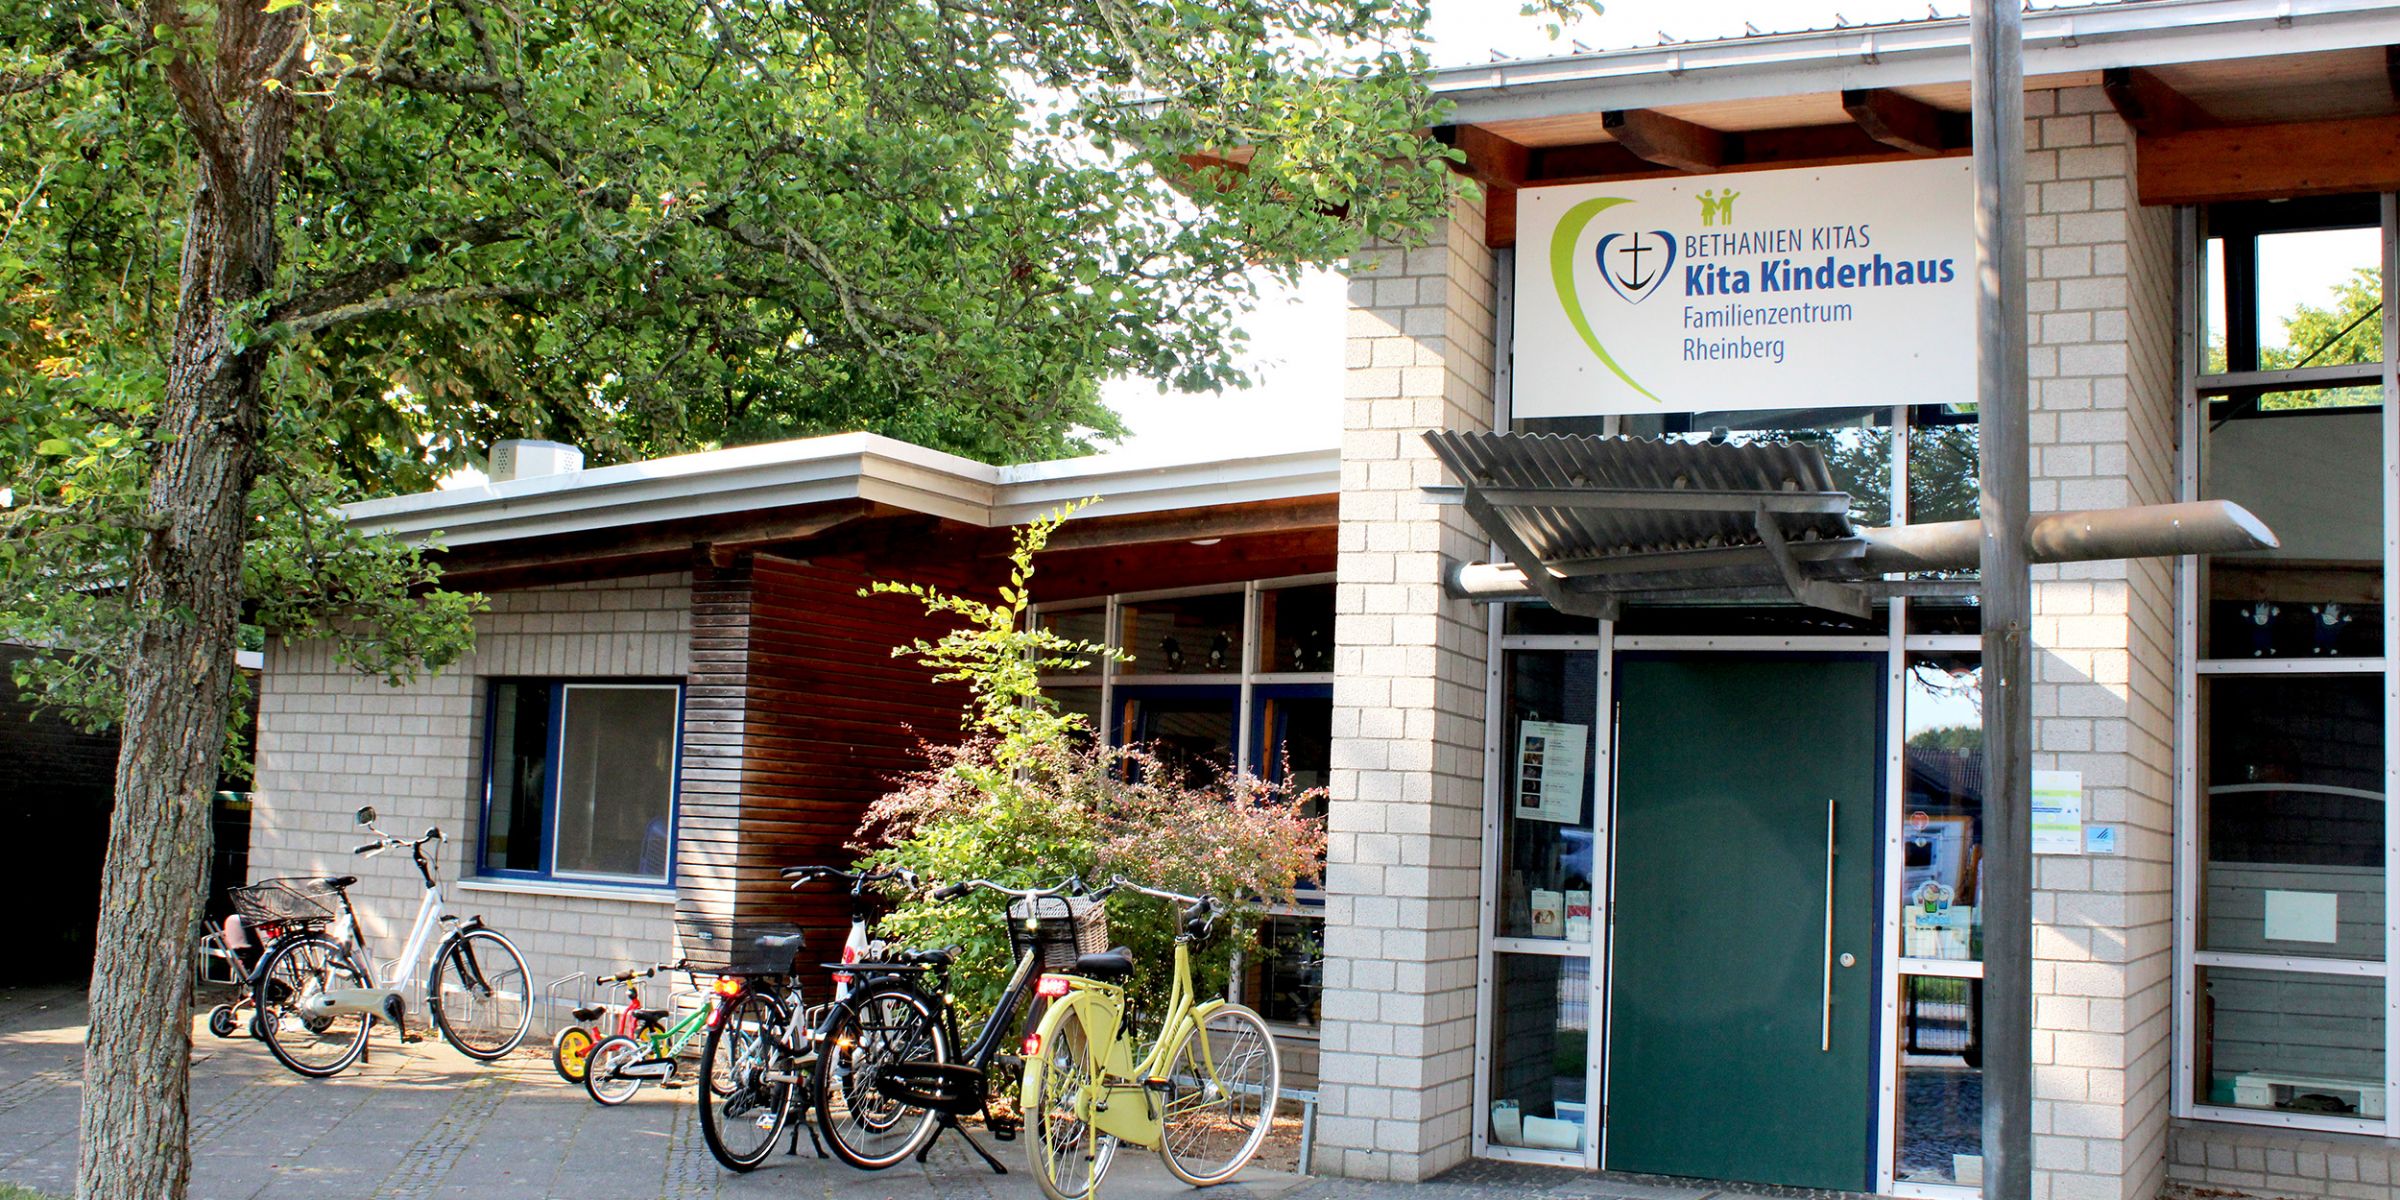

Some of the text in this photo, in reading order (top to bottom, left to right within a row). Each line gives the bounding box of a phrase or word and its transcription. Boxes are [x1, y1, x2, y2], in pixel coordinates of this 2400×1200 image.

[1685, 224, 1871, 259] BETHANIEN KITAS
[1685, 253, 1955, 297] Kita Kinderhaus
[1684, 301, 1852, 329] Familienzentrum
[1683, 335, 1785, 364] Rheinberg
